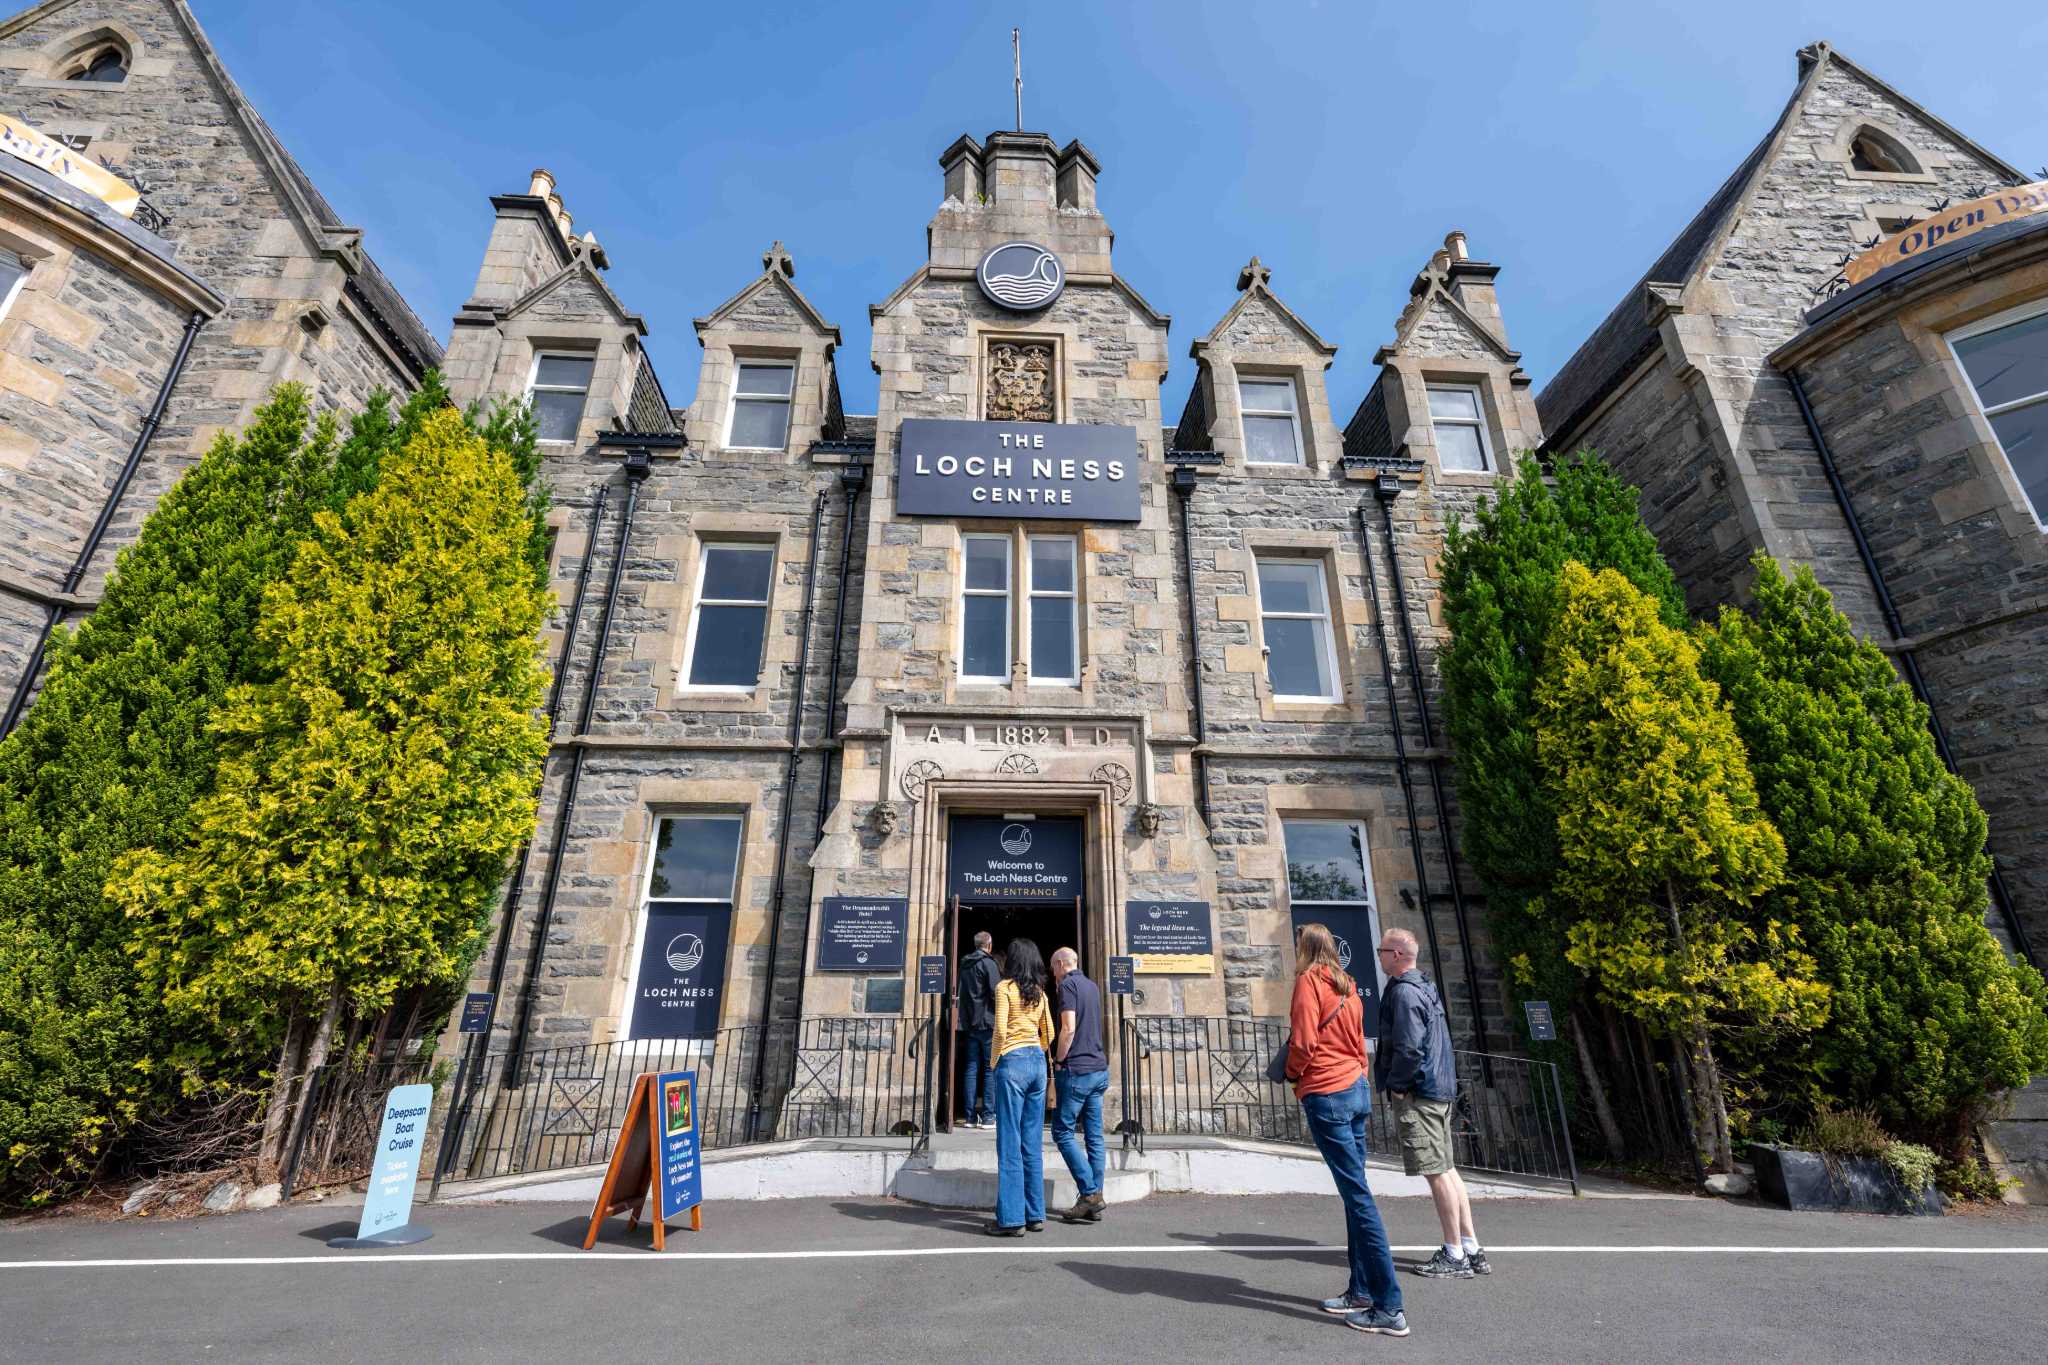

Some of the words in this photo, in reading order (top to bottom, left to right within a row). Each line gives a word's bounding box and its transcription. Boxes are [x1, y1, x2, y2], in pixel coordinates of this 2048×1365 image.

[1900, 209, 1985, 255] Open
[999, 433, 1045, 449] THE
[915, 454, 1013, 478] LOCH
[1032, 458, 1125, 481] NESS
[971, 486, 1073, 504] CENTRE
[926, 724, 941, 744] A
[996, 726, 1050, 745] 1882
[1095, 726, 1111, 745] D
[988, 860, 1033, 870] Welcome
[1035, 861, 1045, 870] to
[964, 872, 982, 882] The
[984, 873, 1008, 883] Loch
[1009, 874, 1033, 883] Ness
[1035, 874, 1068, 883] Centre
[974, 887, 1000, 895] MAIN
[1003, 888, 1058, 896] ENTRANCE
[644, 988, 677, 997] LOCH
[682, 988, 715, 997] NESS
[1358, 988, 1371, 997] SS
[661, 1000, 695, 1008] CENTRE
[388, 1106, 426, 1121] Deepscan
[395, 1123, 414, 1135] Boat
[388, 1138, 413, 1151] Cruise
